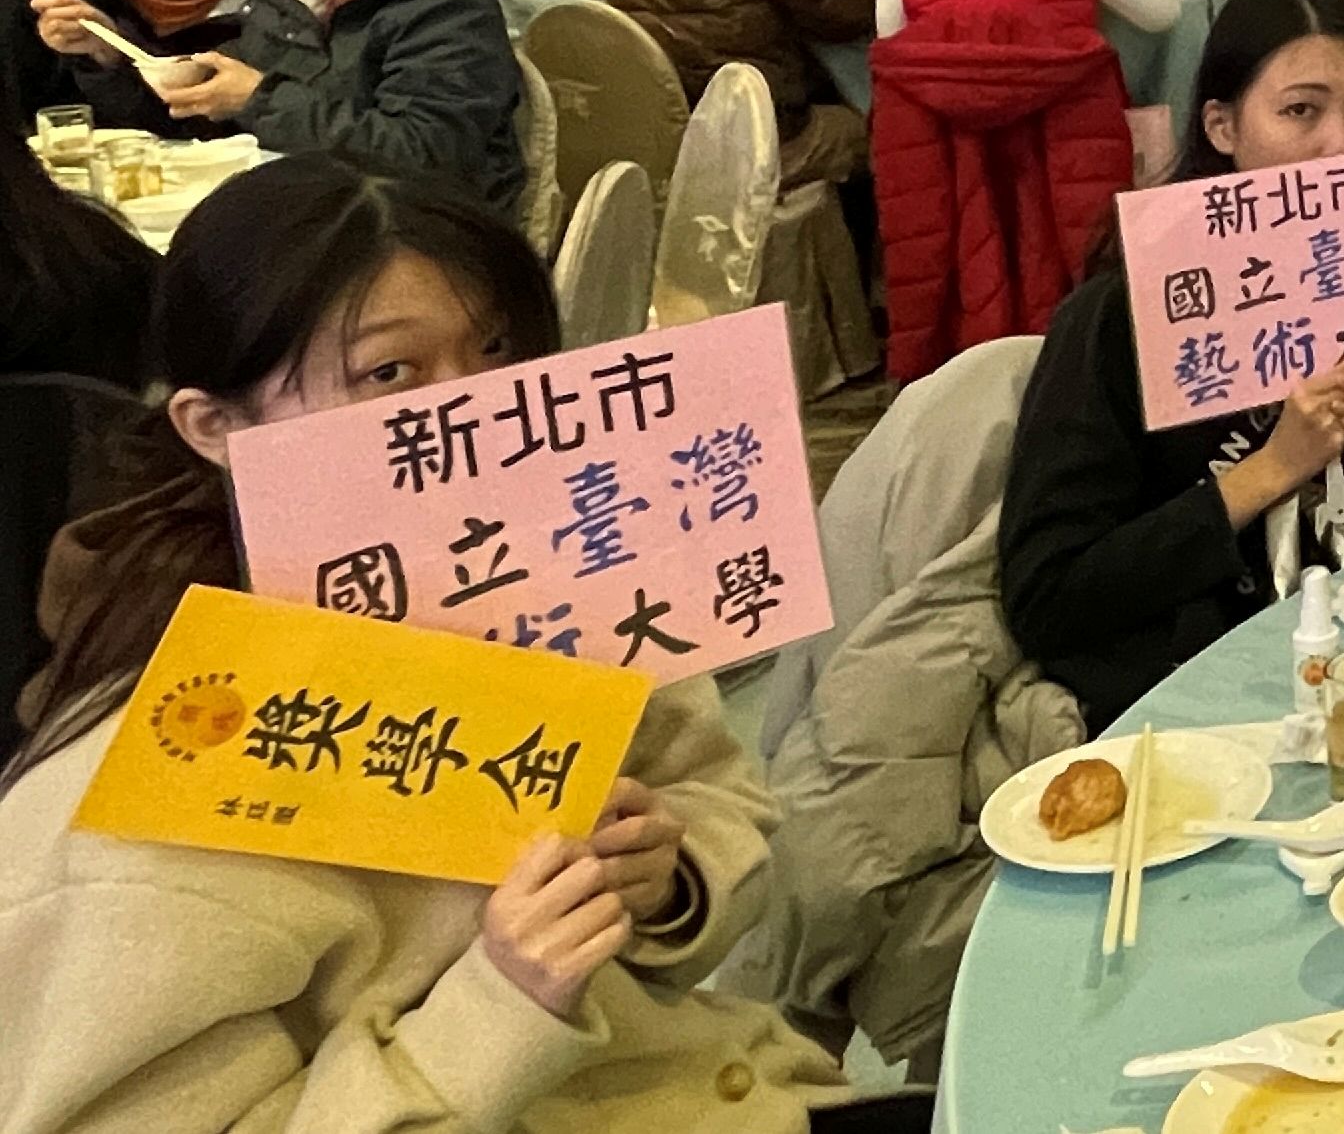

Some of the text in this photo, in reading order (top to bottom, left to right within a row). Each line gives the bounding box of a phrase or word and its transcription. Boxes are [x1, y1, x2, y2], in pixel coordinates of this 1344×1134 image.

[383, 350, 676, 495] 新北市
[316, 421, 764, 623] 國立臺灣
[242, 687, 582, 814] 獎學金
